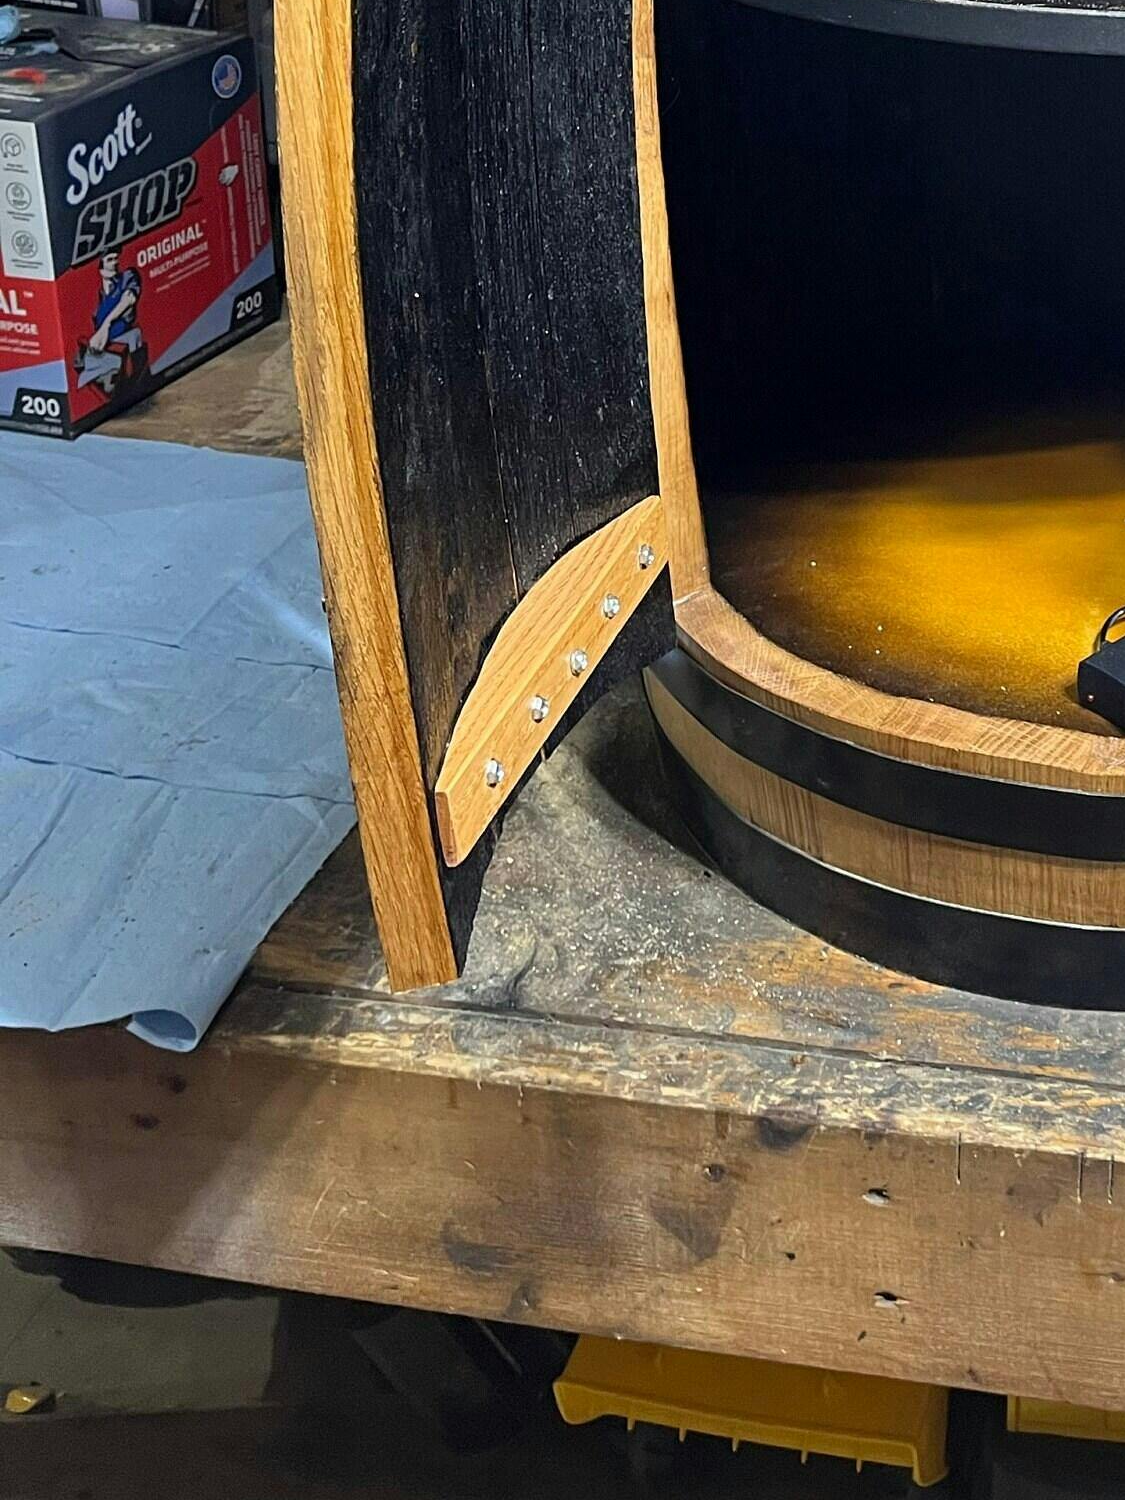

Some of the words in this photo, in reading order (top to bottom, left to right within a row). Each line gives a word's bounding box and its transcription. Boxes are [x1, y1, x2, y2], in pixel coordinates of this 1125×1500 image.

[66, 103, 137, 205] Scott
[71, 156, 198, 266] SHOP
[137, 224, 204, 268] ORIGINAL
[236, 291, 262, 320] 200
[21, 395, 61, 417] 200
